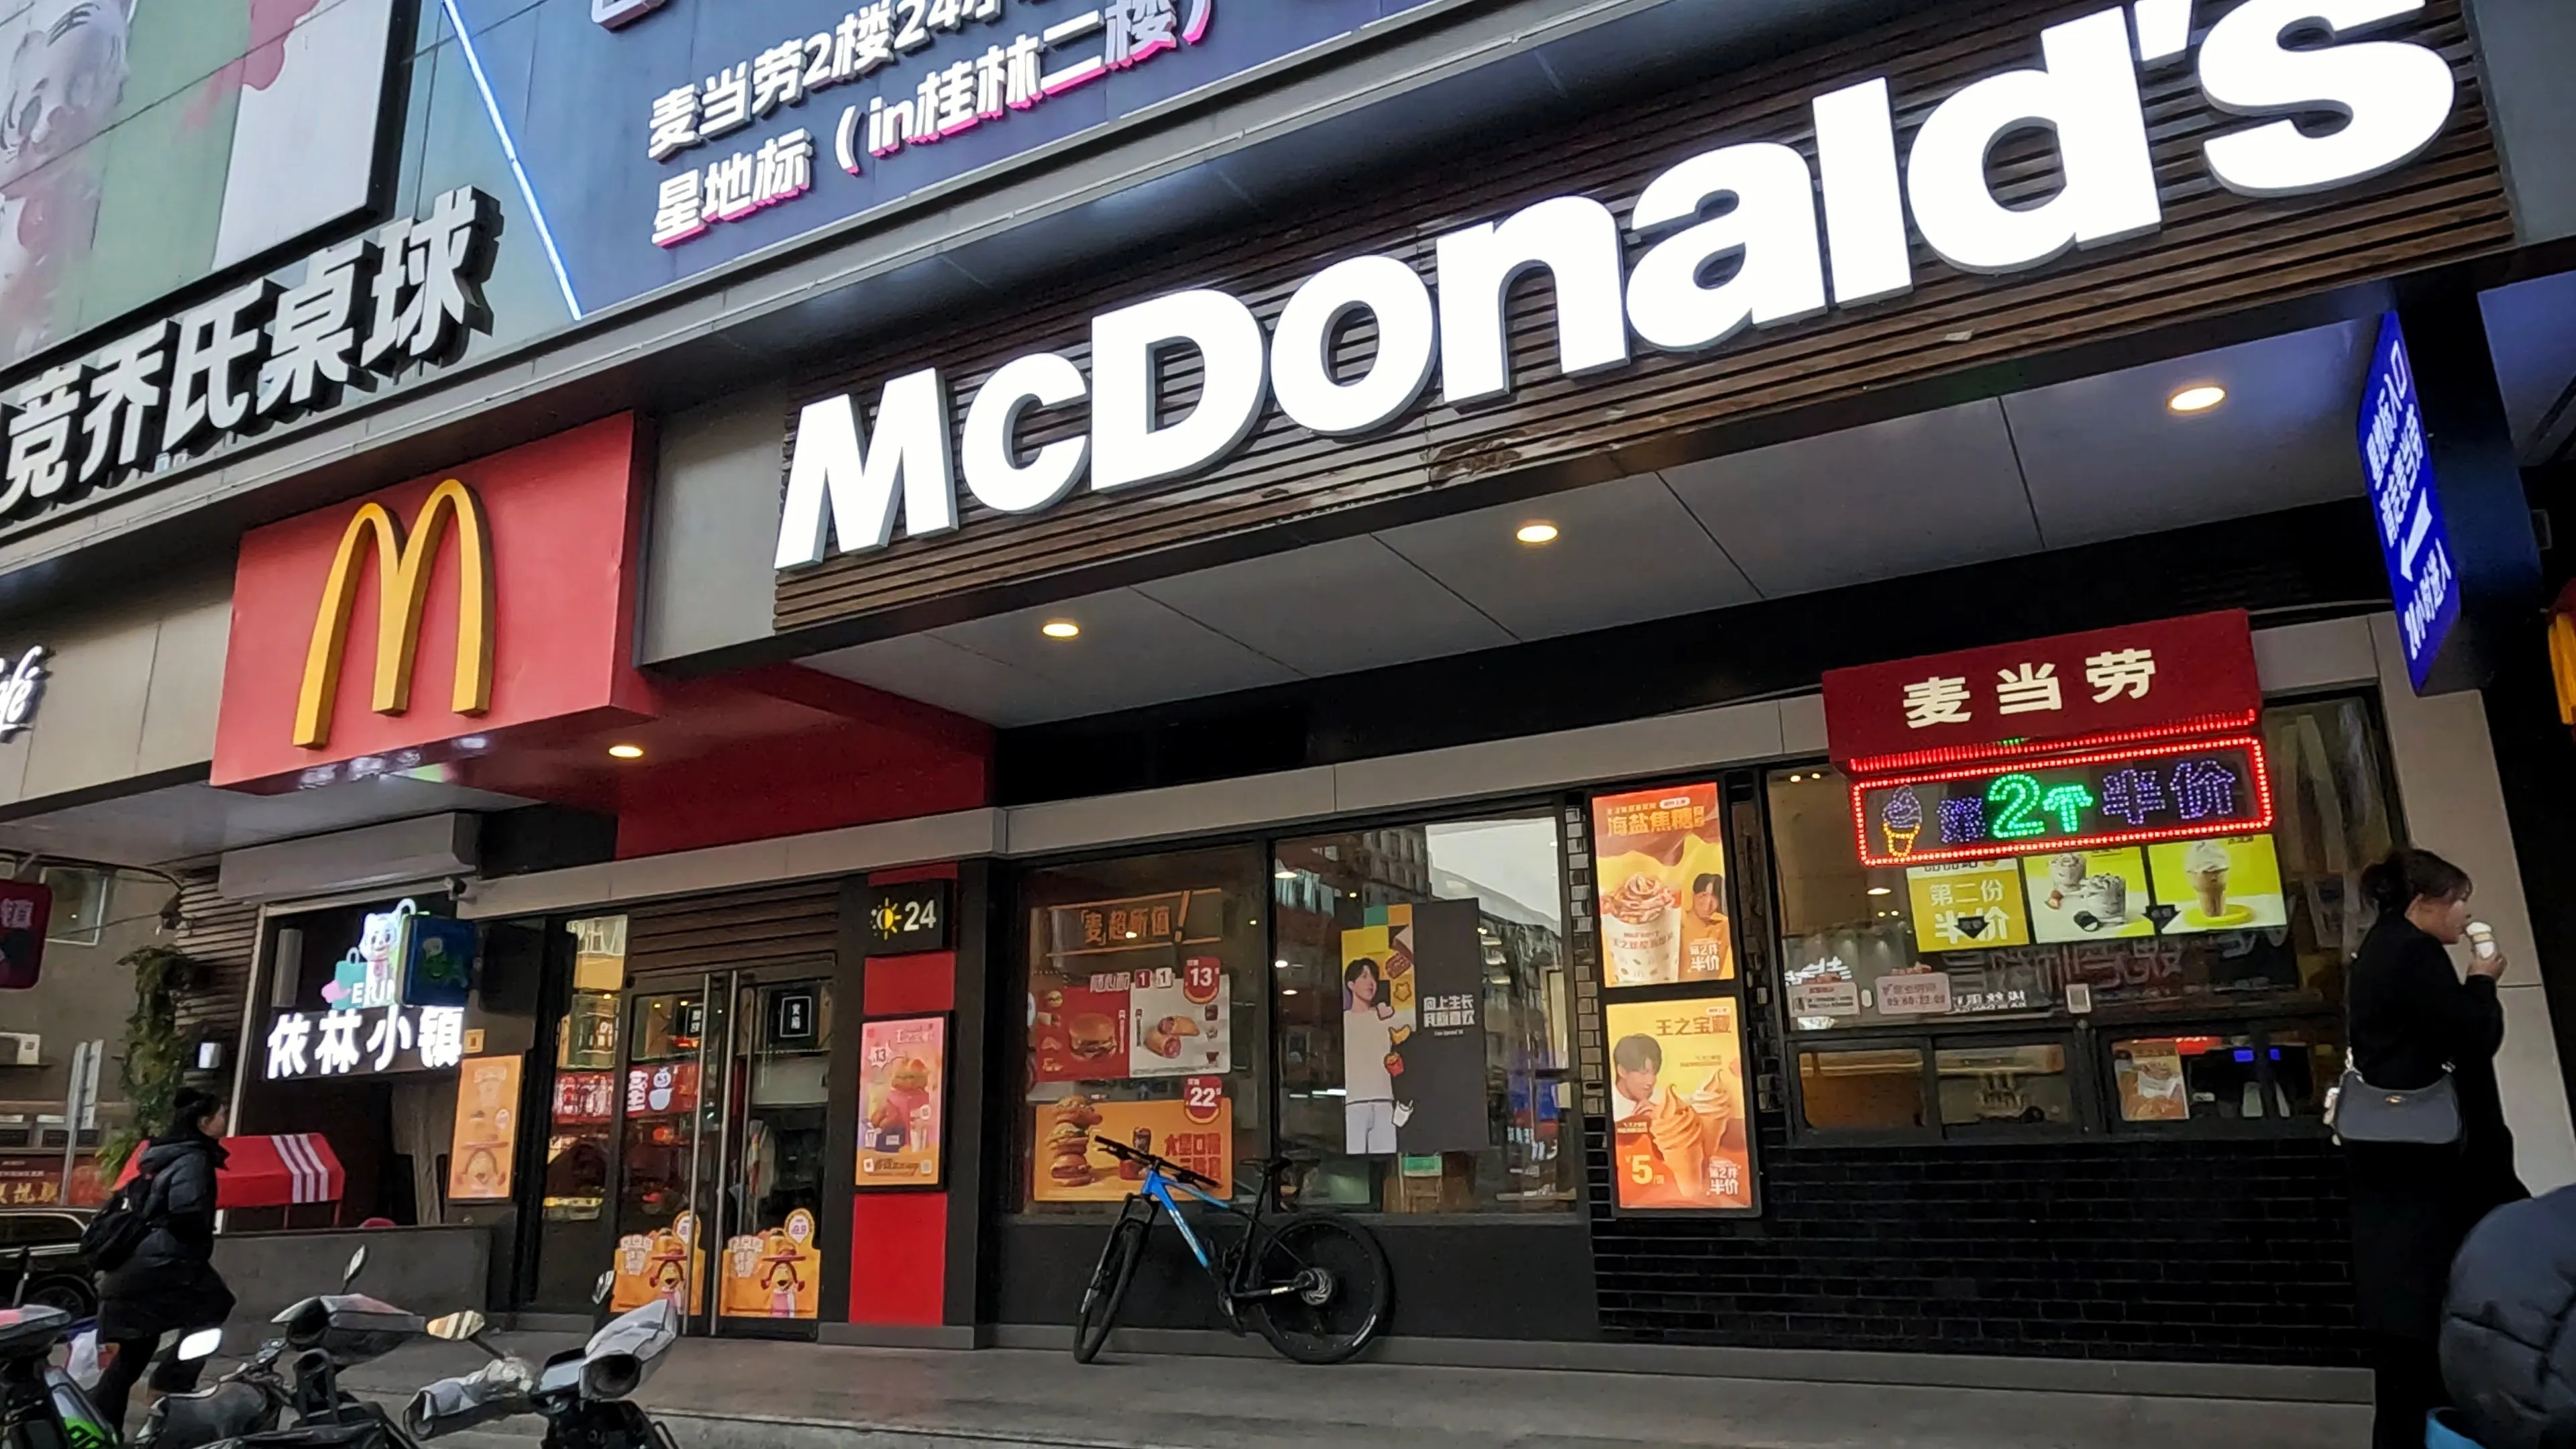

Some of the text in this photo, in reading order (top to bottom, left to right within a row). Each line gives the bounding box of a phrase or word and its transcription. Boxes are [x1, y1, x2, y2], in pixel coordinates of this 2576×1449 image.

[773, 0, 2457, 576] McDonald's
[1902, 648, 2157, 729] 麦当劳
[903, 899, 937, 932] 24
[1930, 878, 2004, 906] 第二份
[1934, 906, 2010, 945] 半价
[267, 1006, 465, 1079] 依林小镇
